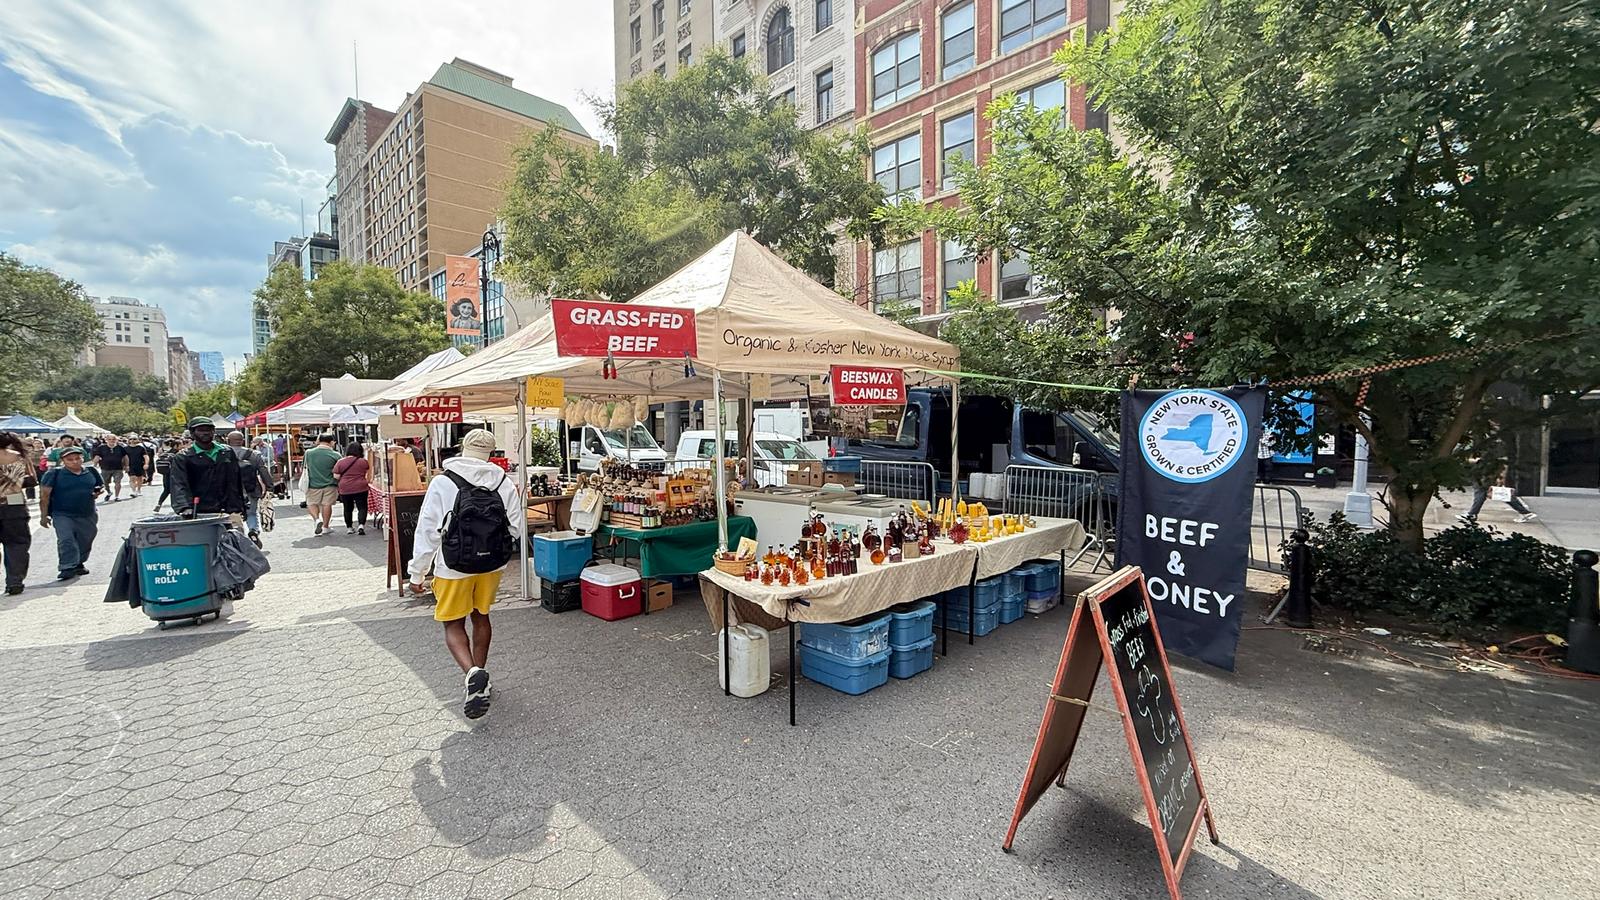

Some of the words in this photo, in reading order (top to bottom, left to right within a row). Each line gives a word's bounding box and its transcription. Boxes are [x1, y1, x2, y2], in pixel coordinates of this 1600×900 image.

[570, 307, 684, 330] GRASS-FED
[608, 335, 659, 353] BEEF
[722, 328, 782, 357] Organic
[787, 337, 798, 352] &
[851, 339, 876, 355] New
[879, 343, 901, 359] York
[841, 370, 894, 385] BEESWAX
[403, 397, 460, 408] MAPLE
[850, 387, 899, 400] CANDLES
[404, 411, 460, 422] SYRUP
[1149, 402, 1171, 425] NEW
[1172, 395, 1208, 407] YORK
[1209, 399, 1238, 428] STATE
[1146, 434, 1175, 471] GROWN
[1175, 465, 1184, 475] &
[1186, 438, 1237, 476] CERTIFIED
[1145, 513, 1220, 547] BEEF
[145, 562, 173, 571] WE'RE
[166, 568, 180, 577] ON
[1166, 550, 1186, 577] &
[154, 576, 178, 585] ROLL
[1144, 573, 1235, 618] ONEY
